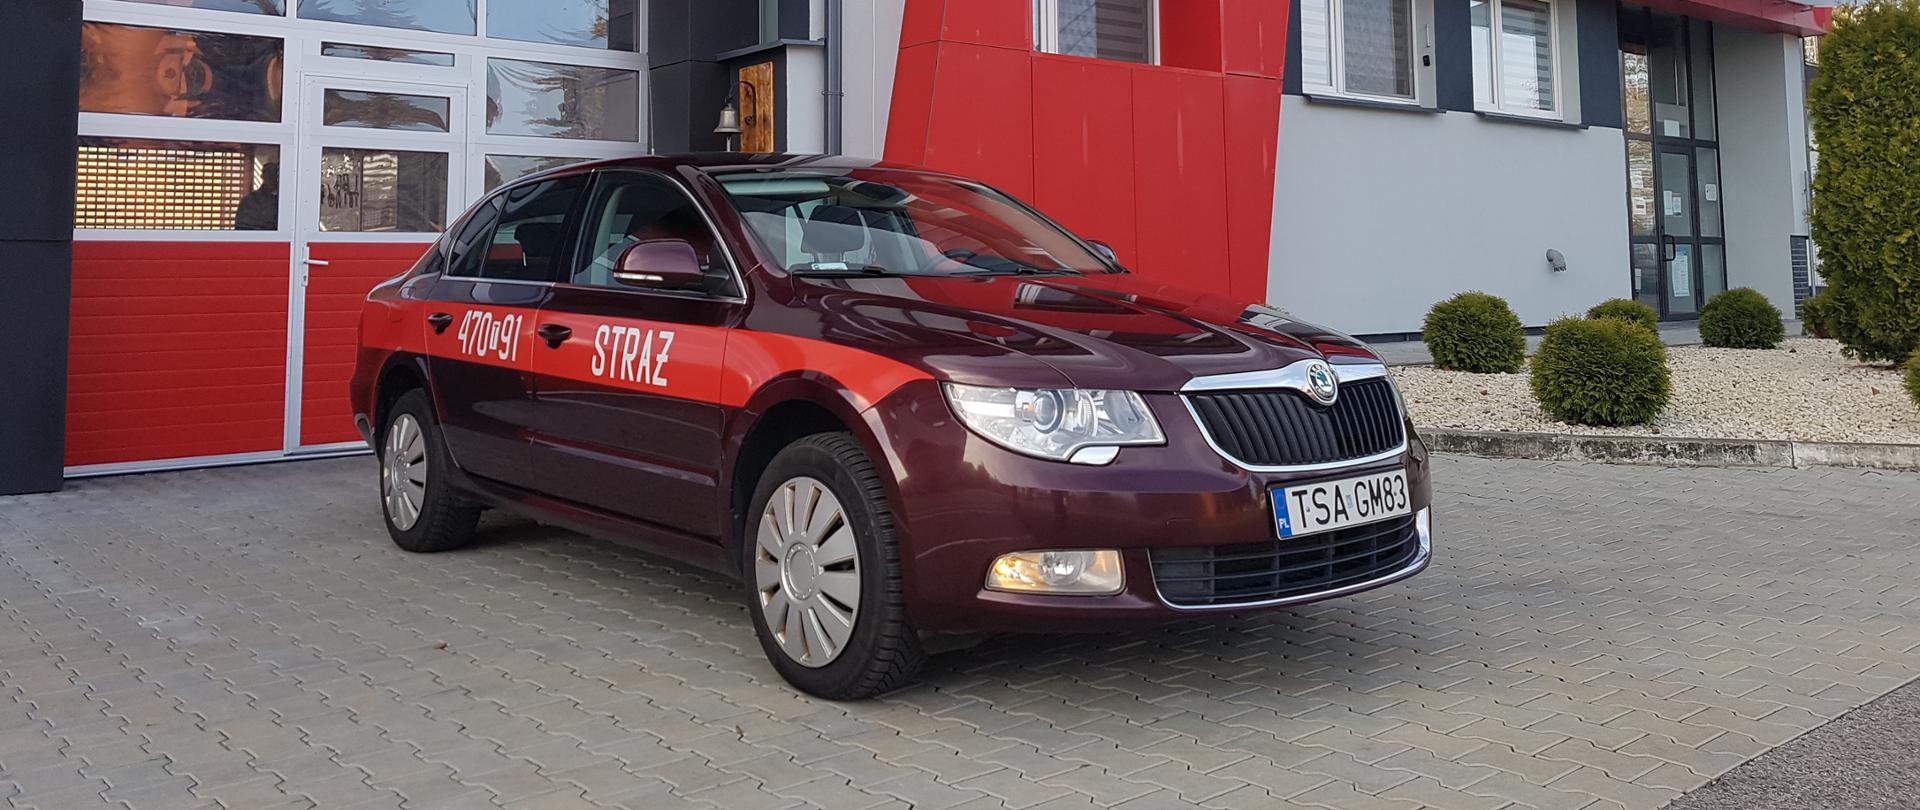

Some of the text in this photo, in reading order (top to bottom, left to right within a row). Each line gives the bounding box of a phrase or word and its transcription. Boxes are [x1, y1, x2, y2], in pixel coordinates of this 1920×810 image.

[591, 324, 675, 387] STRAŻ
[1279, 518, 1290, 529] PL
[1291, 474, 1407, 528] TSA GM83
